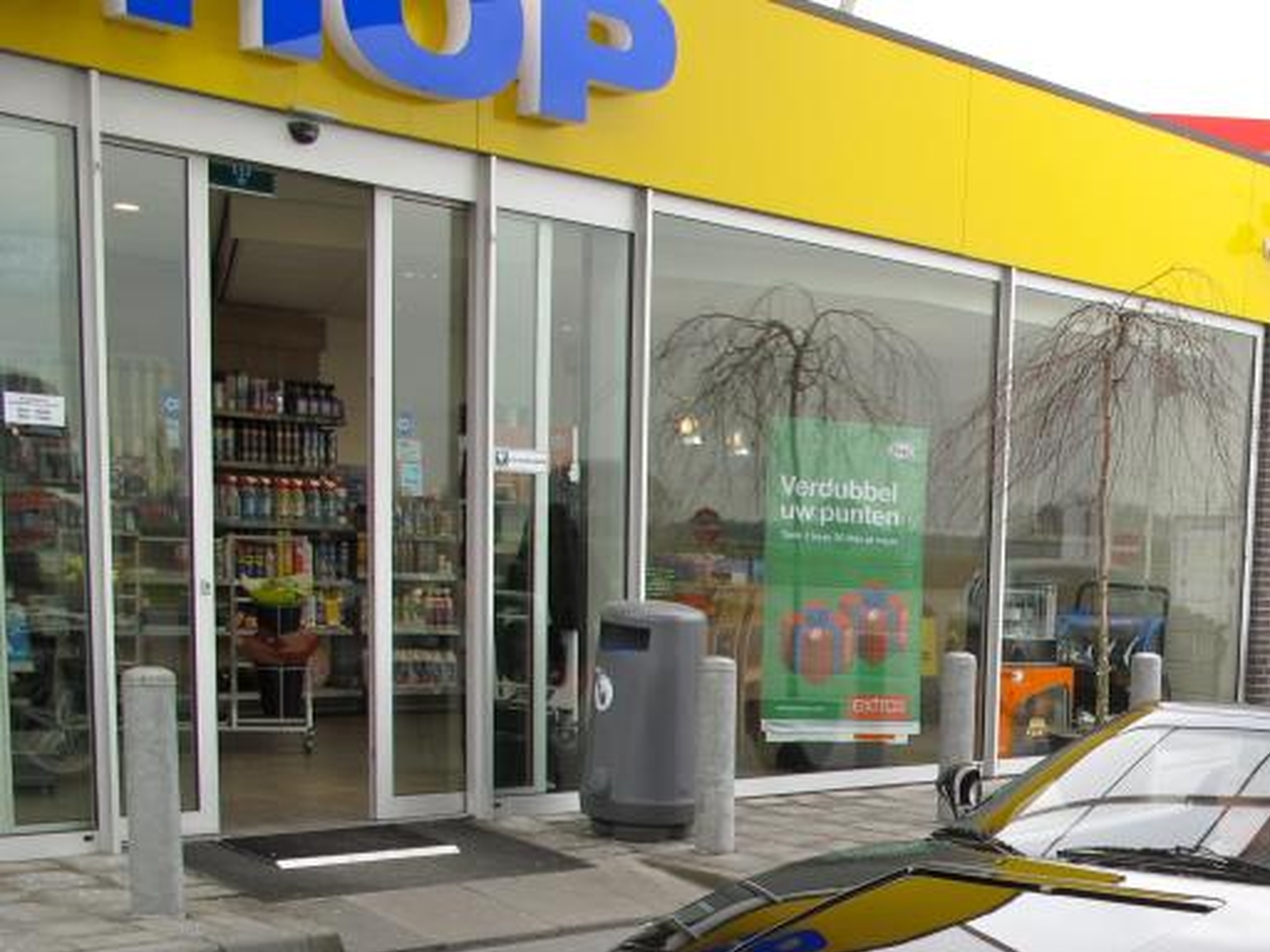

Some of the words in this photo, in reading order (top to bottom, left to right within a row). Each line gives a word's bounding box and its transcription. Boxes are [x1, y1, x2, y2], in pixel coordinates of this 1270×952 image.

[780, 475, 898, 504] Verdubbel
[780, 504, 812, 521] uw
[820, 505, 900, 527] punten
